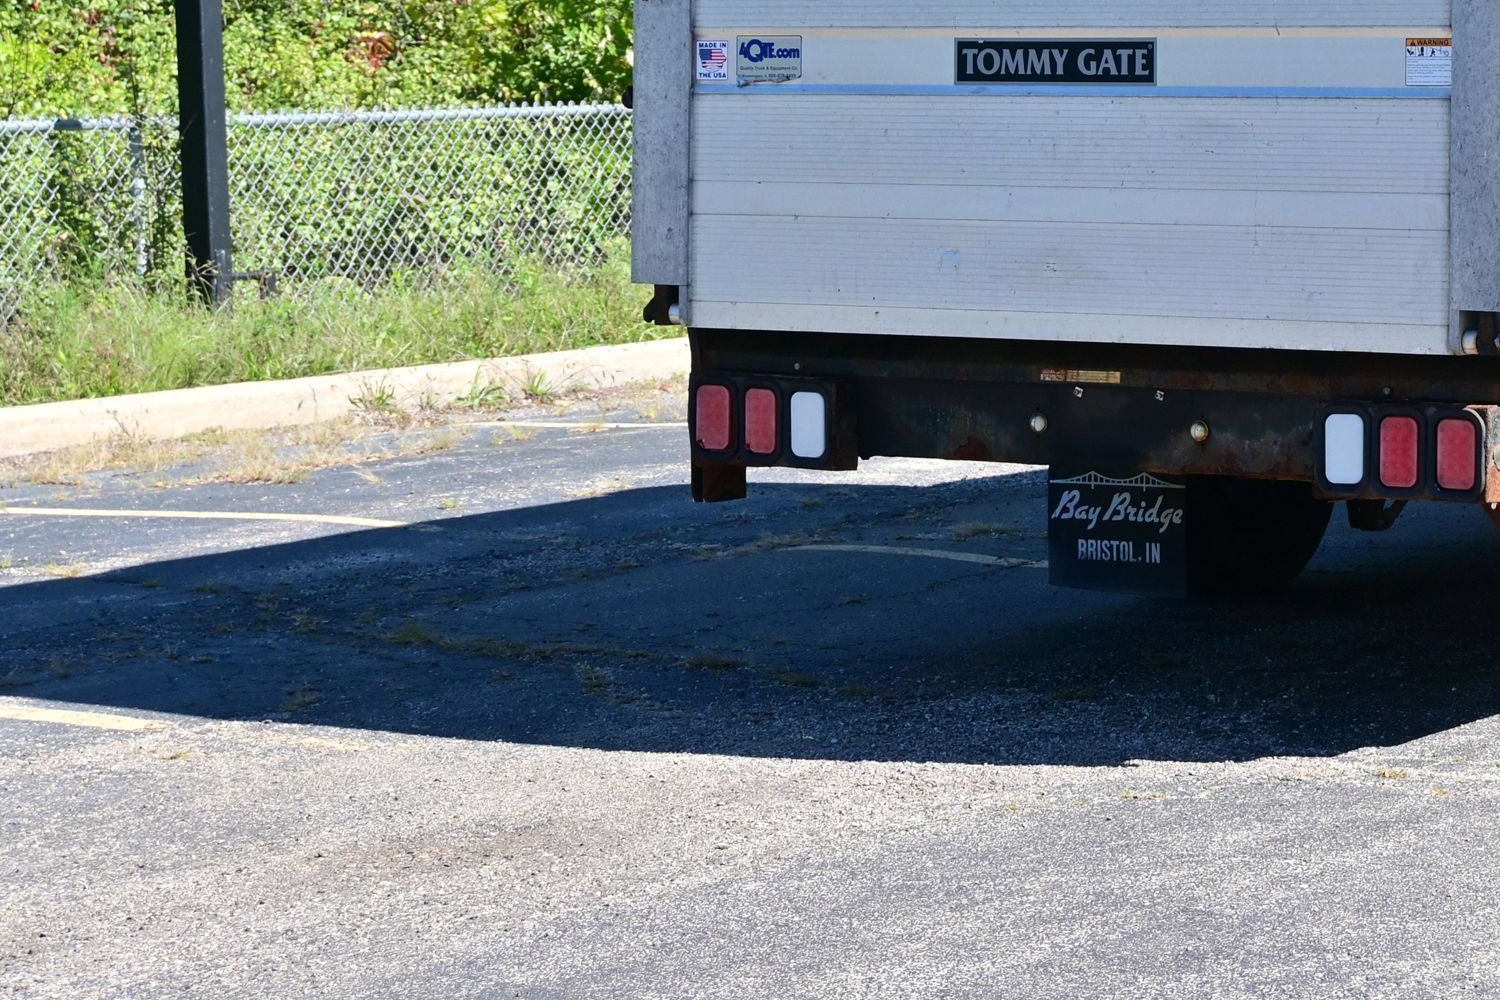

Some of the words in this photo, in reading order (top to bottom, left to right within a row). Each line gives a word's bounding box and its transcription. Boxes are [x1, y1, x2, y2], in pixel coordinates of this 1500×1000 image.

[961, 48, 1069, 75] TOMMY
[1077, 48, 1150, 76] GATE
[1051, 489, 1102, 530] Bay
[1102, 491, 1184, 533] Bridge
[1145, 542, 1161, 564] IN
